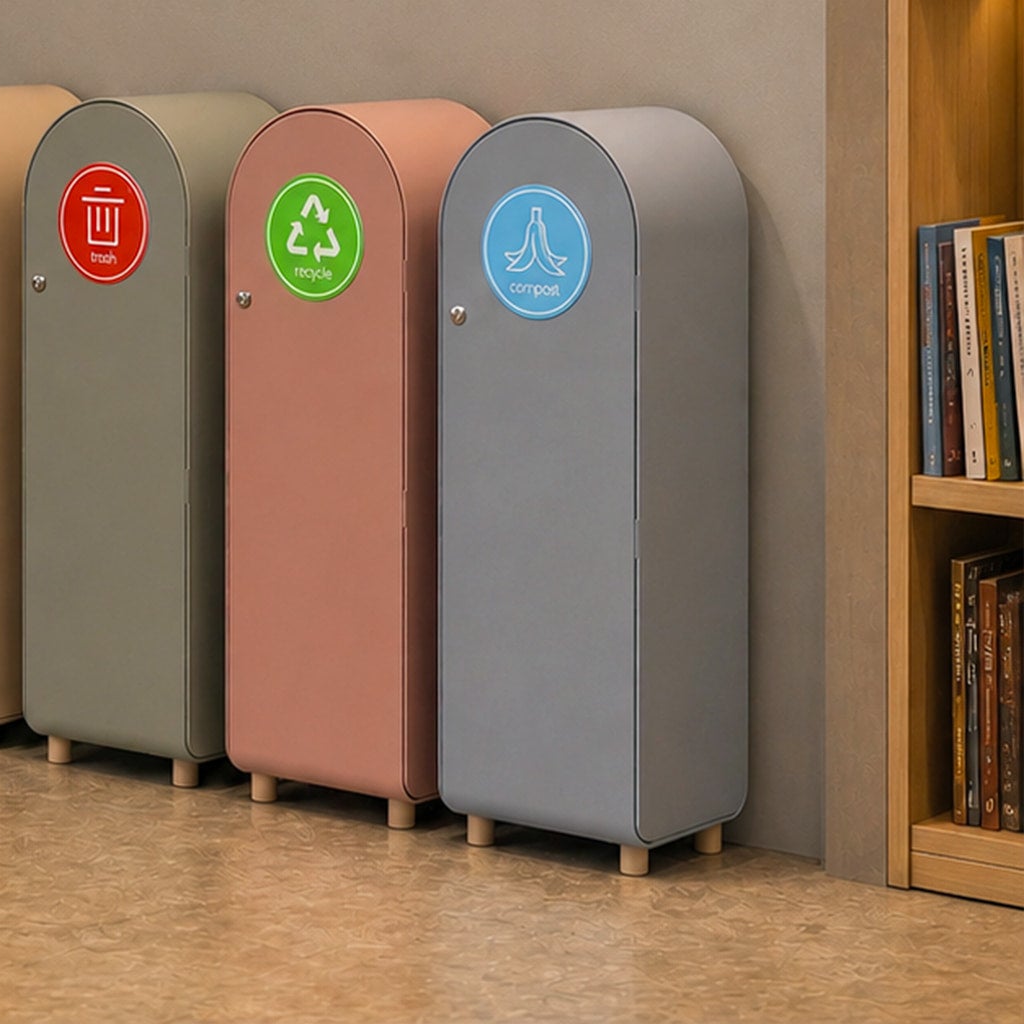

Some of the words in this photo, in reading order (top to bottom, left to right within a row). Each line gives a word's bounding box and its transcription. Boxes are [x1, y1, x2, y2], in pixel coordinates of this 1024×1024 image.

[90, 251, 118, 265] trash
[294, 266, 333, 283] recycle
[509, 282, 561, 298] compost
